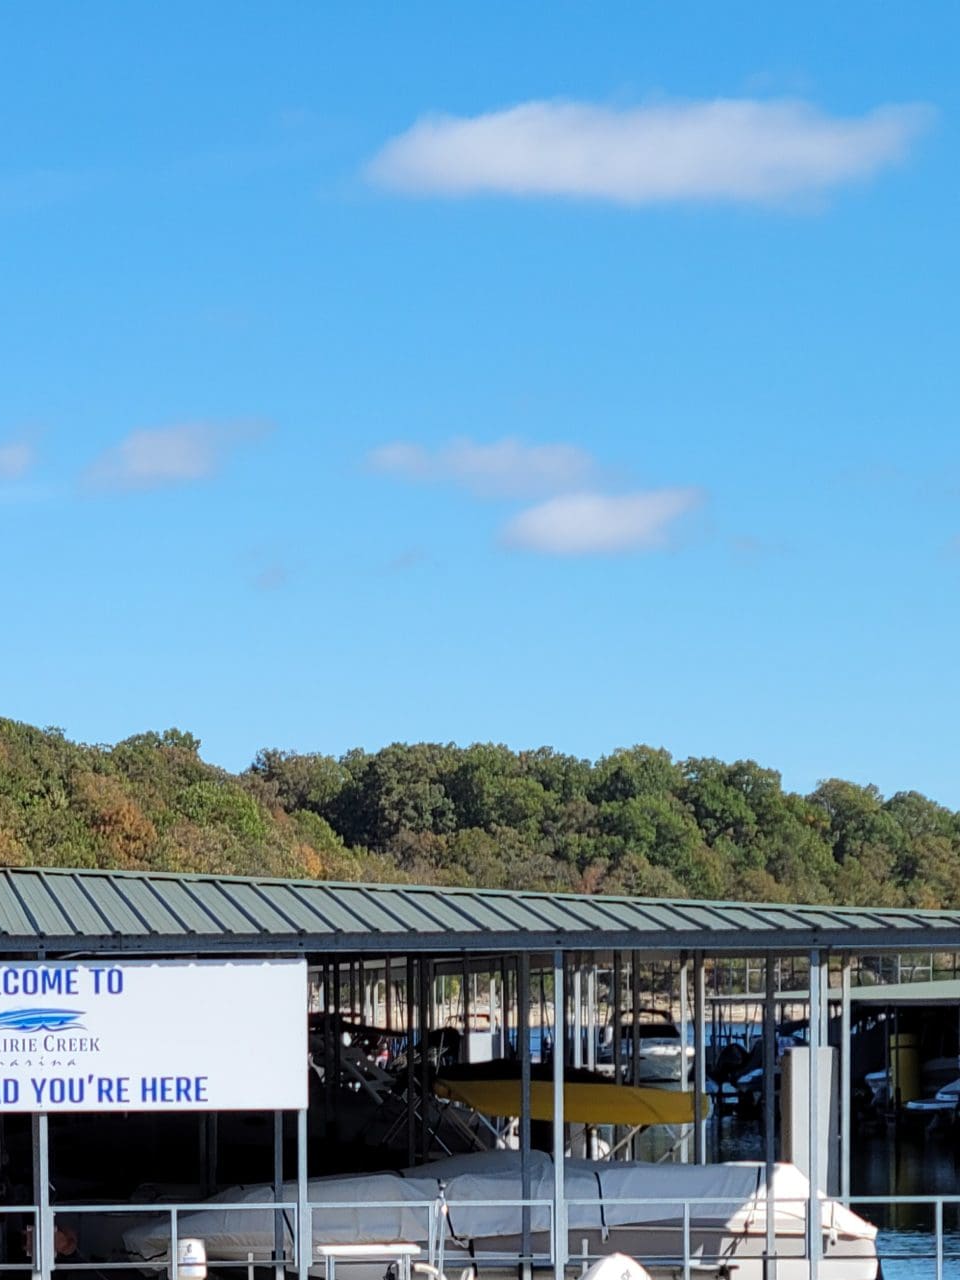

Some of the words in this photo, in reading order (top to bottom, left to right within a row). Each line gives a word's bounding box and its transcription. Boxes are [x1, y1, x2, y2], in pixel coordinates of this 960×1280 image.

[88, 968, 124, 995] TO
[43, 1034, 101, 1052] CREEK
[30, 1074, 130, 1104] YOU'RE
[140, 1076, 209, 1103] HERE
